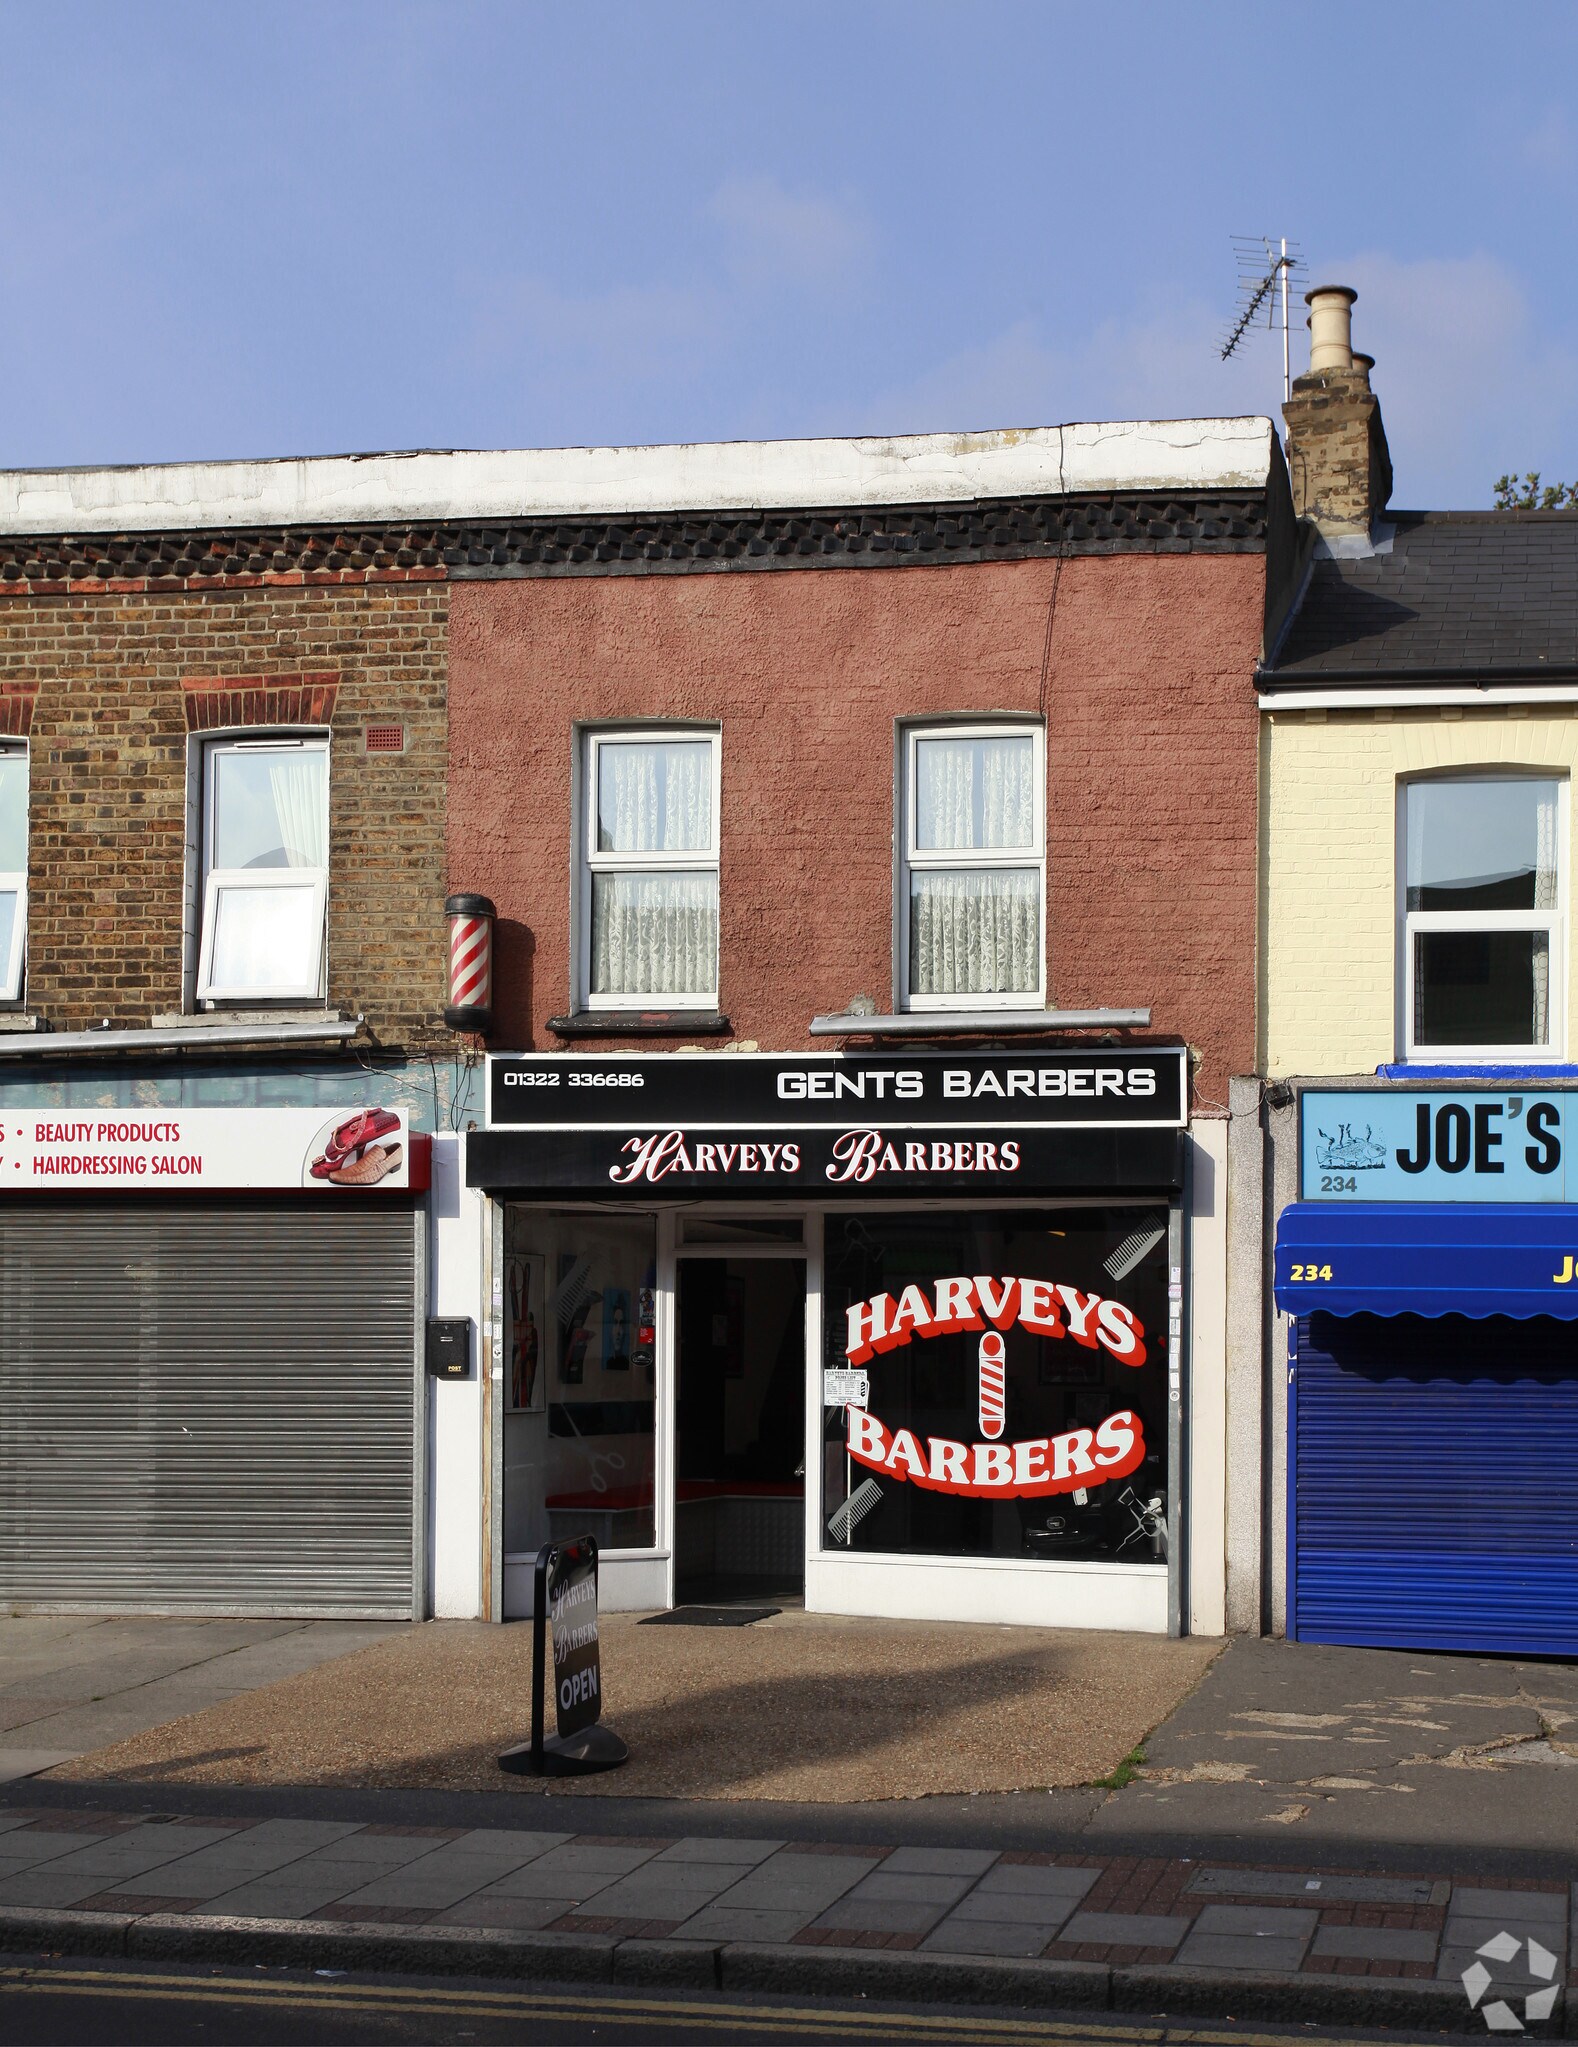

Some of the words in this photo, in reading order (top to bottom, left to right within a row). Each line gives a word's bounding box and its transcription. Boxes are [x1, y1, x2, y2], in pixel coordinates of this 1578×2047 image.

[503, 1073, 561, 1087] 01322
[567, 1073, 645, 1087] 336686
[776, 1070, 924, 1099] GENTS
[942, 1068, 1158, 1098] BARBERS
[35, 1123, 94, 1143] BEAUTY
[97, 1123, 181, 1143] PRODUCTS
[1396, 1097, 1561, 1175] JOE'S
[33, 1156, 147, 1175] HAIRDRESSING
[151, 1156, 203, 1175] SALON
[609, 1130, 801, 1183] HARVEYS
[825, 1129, 1021, 1183] BARBERS
[1320, 1176, 1358, 1193] 234
[1291, 1264, 1333, 1281] 234
[1553, 1256, 1578, 1283] J
[845, 1275, 1140, 1360] HARVEYS
[845, 1404, 1140, 1491] BARBERS
[552, 1579, 596, 1622] HARVEYS
[555, 1621, 598, 1664] BARBERS
[561, 1665, 597, 1710] OPEN
